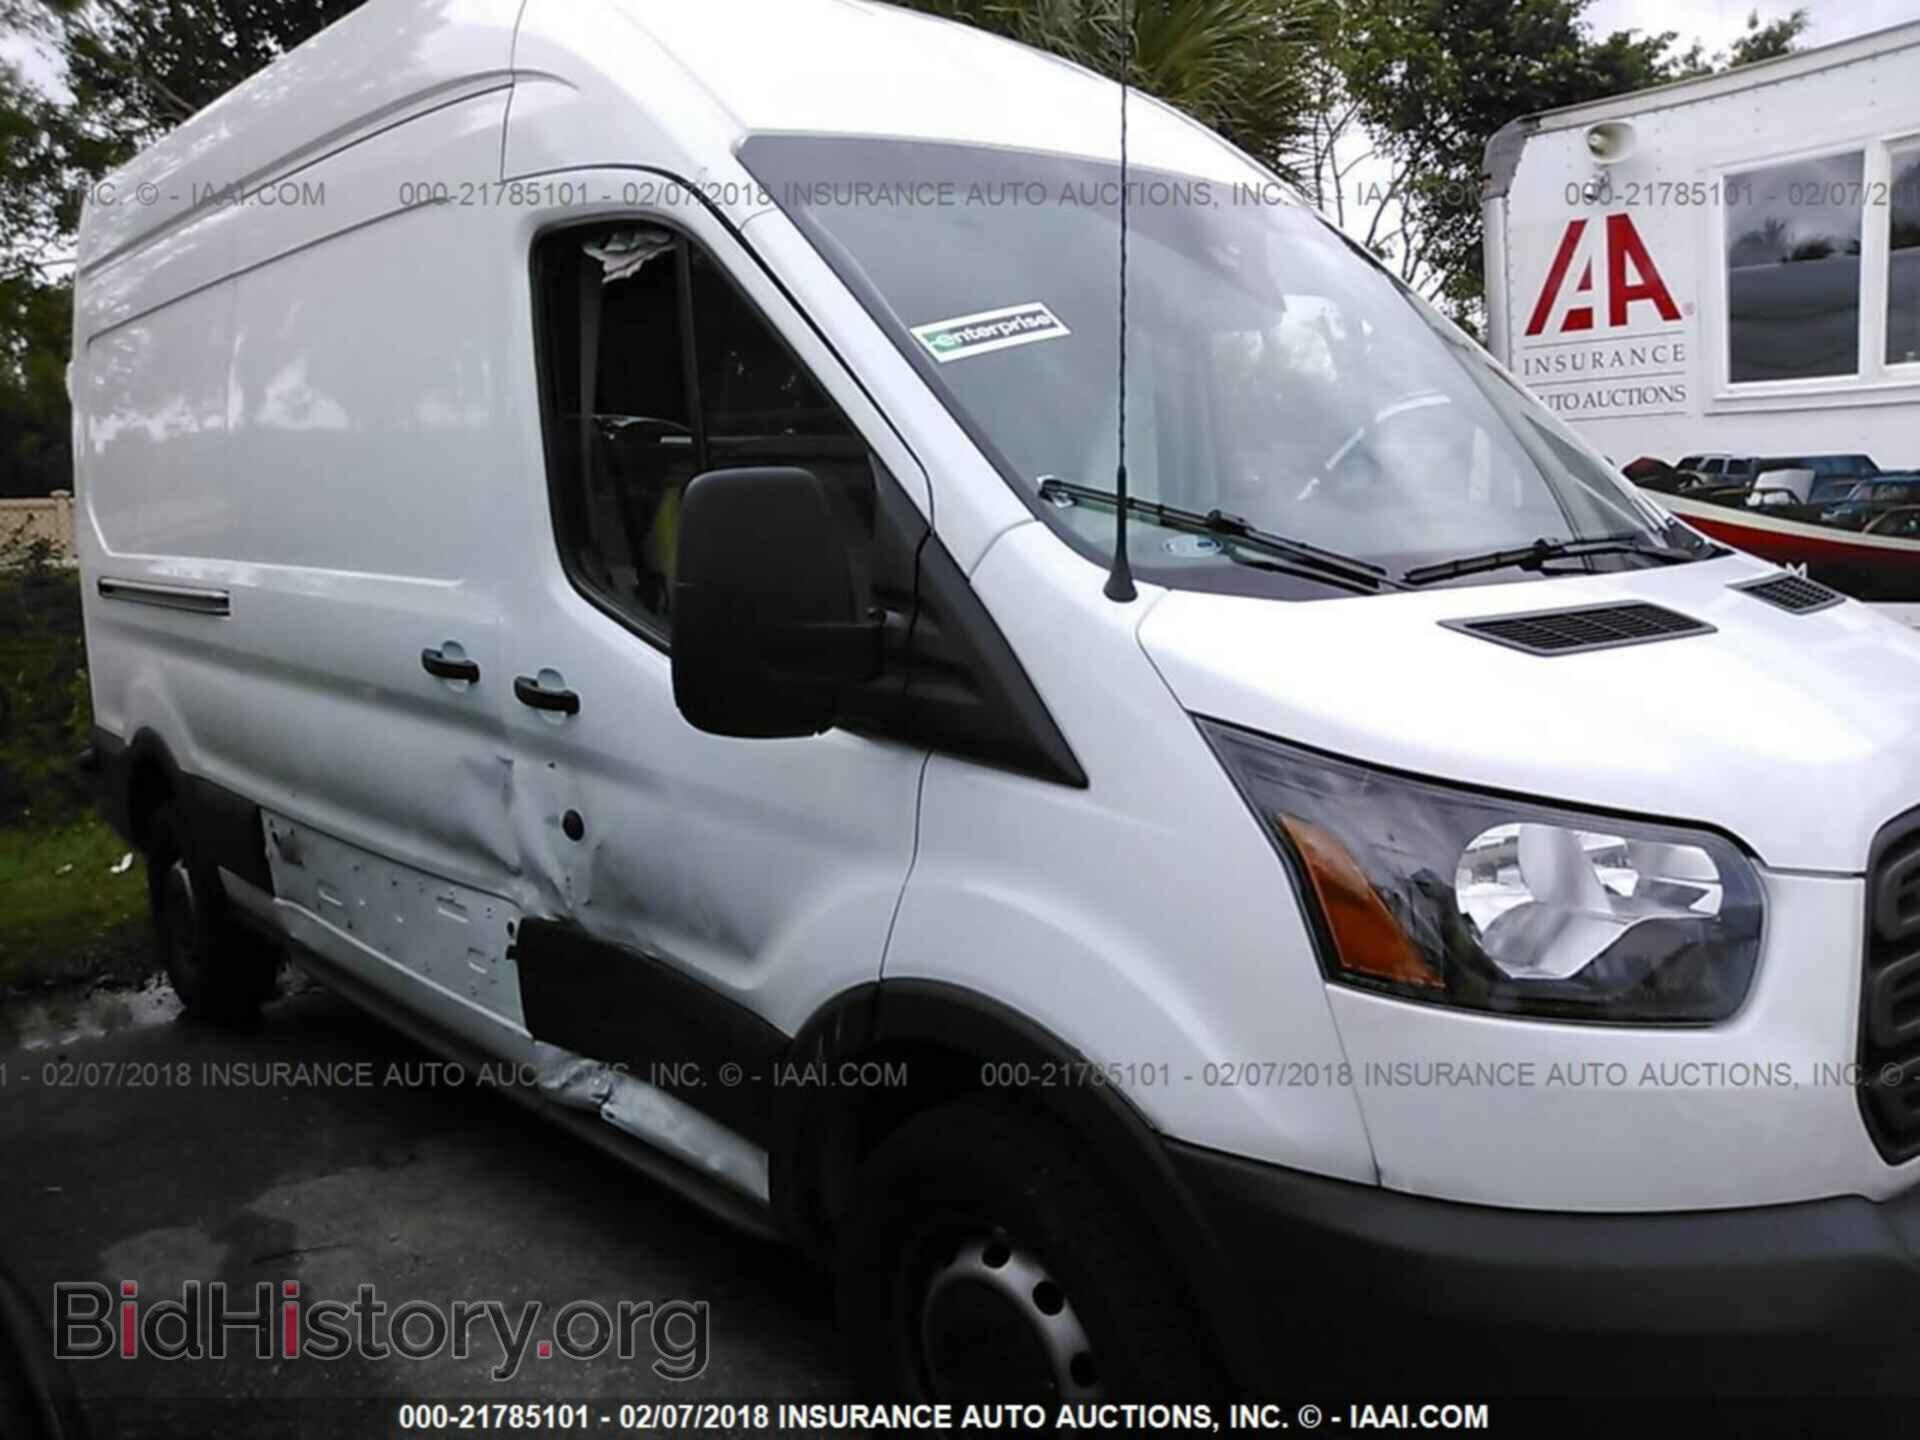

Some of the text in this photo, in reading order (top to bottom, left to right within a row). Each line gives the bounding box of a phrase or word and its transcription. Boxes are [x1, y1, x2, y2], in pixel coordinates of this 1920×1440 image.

[926, 311, 1053, 348] enterprise
[1524, 344, 1685, 376] INSURANCE
[1539, 384, 1687, 411] TO AUCTIONS
